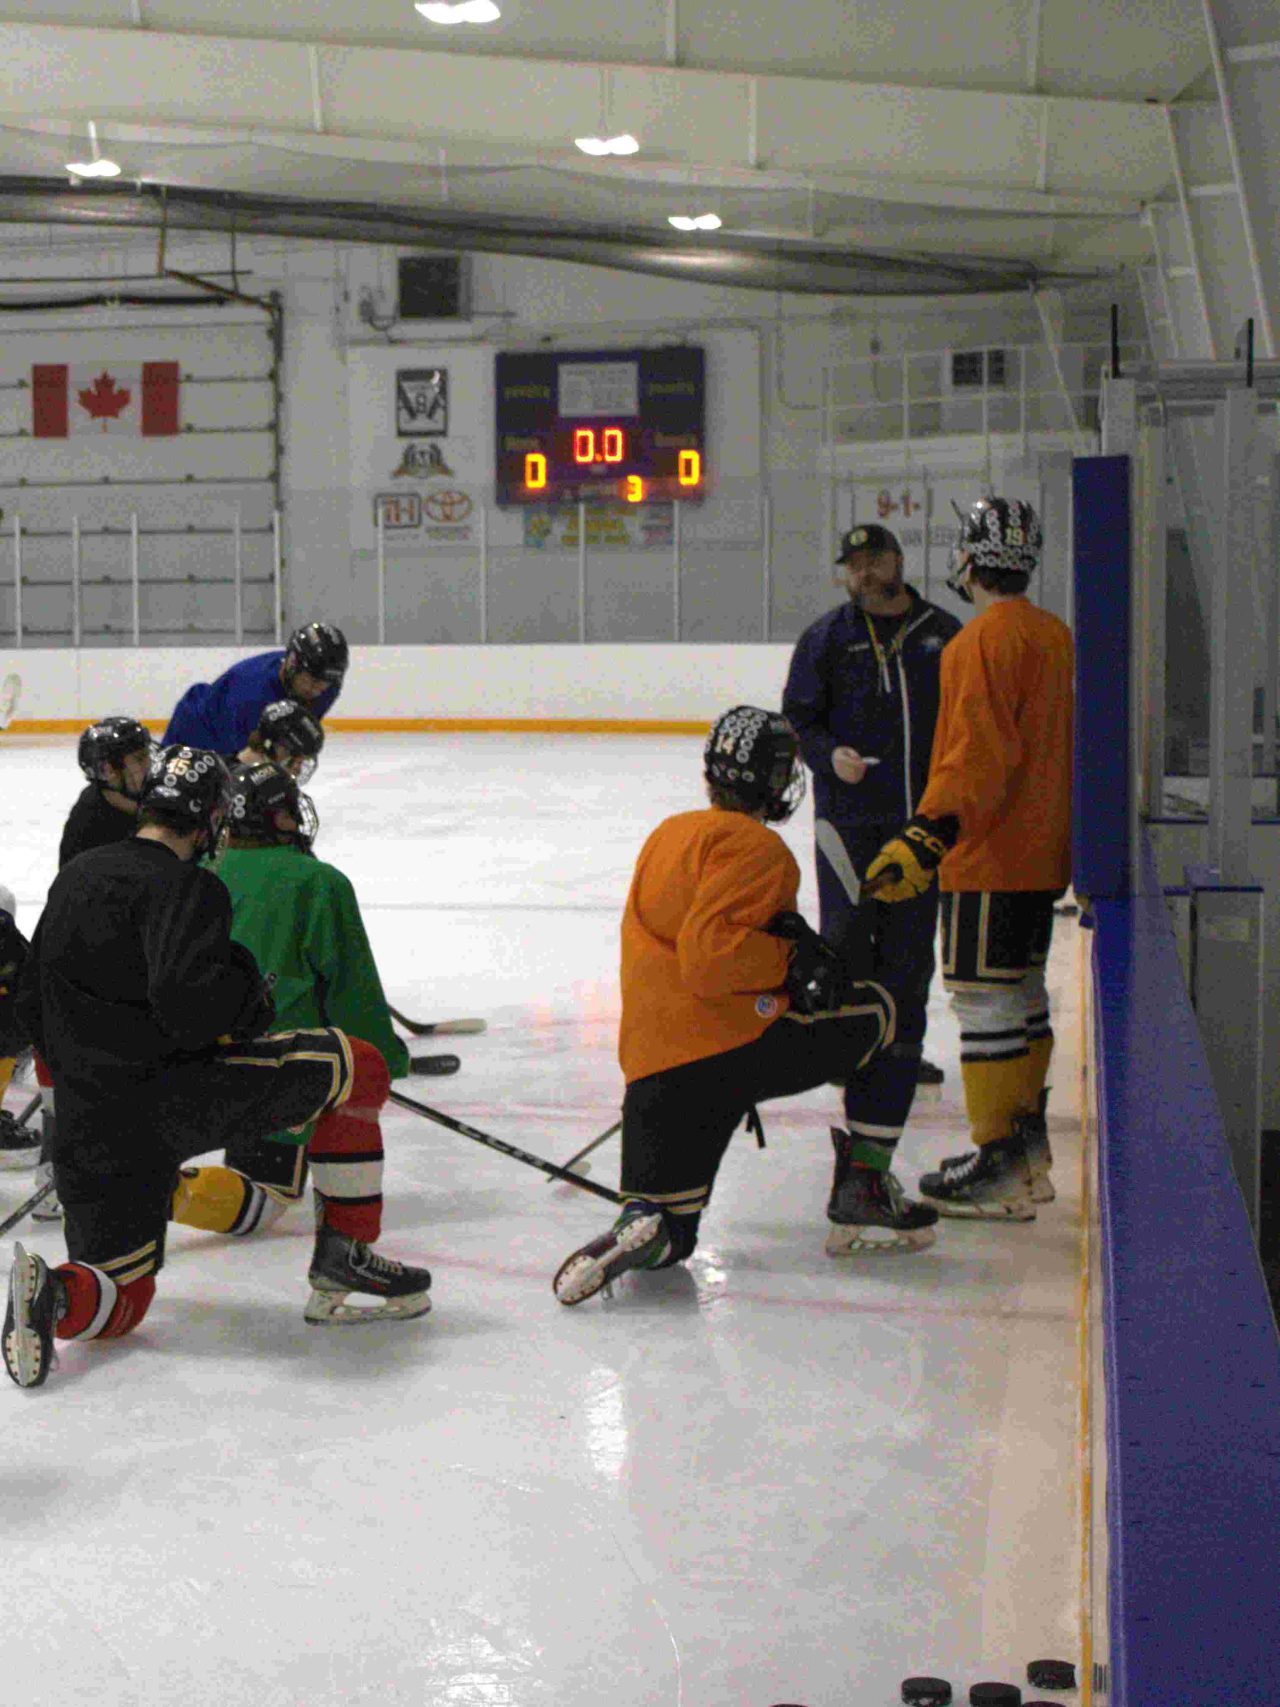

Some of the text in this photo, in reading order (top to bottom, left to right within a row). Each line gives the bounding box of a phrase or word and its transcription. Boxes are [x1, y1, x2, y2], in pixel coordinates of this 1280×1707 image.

[525, 452, 547, 489] 0
[678, 449, 701, 486] 0
[626, 475, 643, 502] 3
[905, 826, 945, 854] CC
